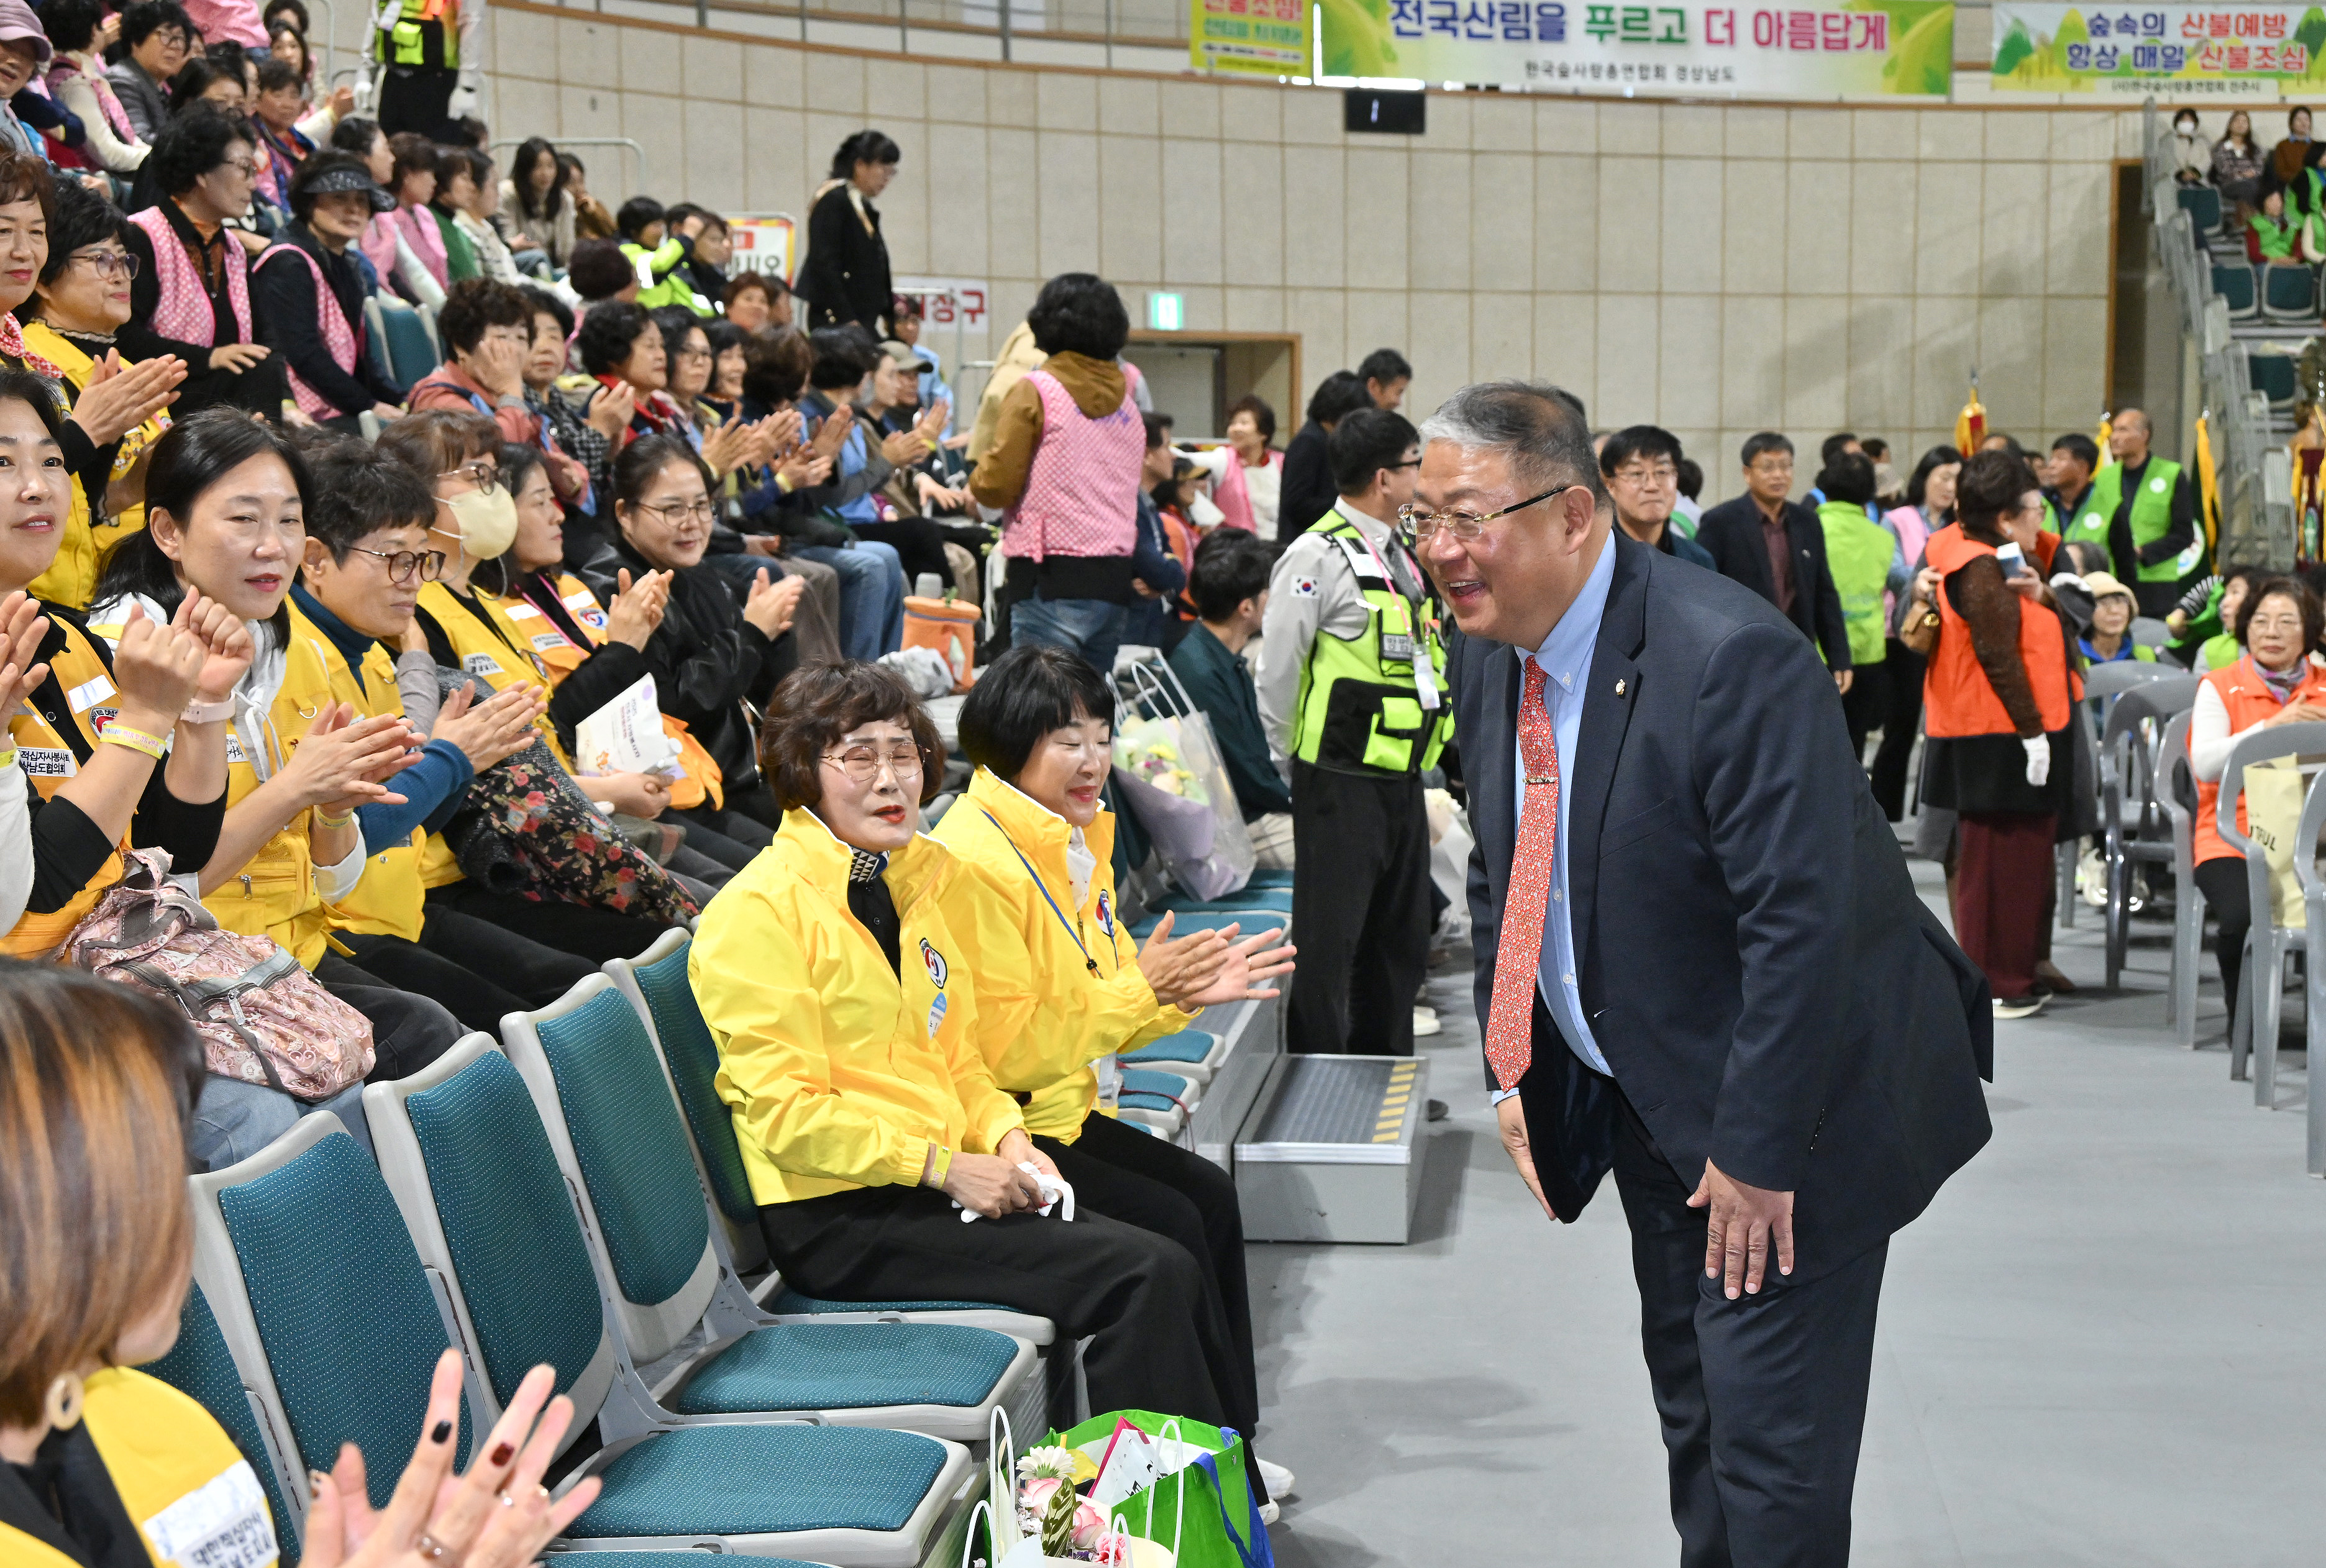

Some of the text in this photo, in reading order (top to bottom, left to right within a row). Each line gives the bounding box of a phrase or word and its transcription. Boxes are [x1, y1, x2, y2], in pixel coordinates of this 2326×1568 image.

[1391, 0, 1886, 51] 전국산림을 푸르고 더 아름답게
[2087, 11, 2287, 39] 숲속의 산불예방
[2068, 43, 2307, 72] 항상 매일 산불조심
[919, 289, 985, 324] 장구
[21, 750, 70, 763] 적십자사봉사회
